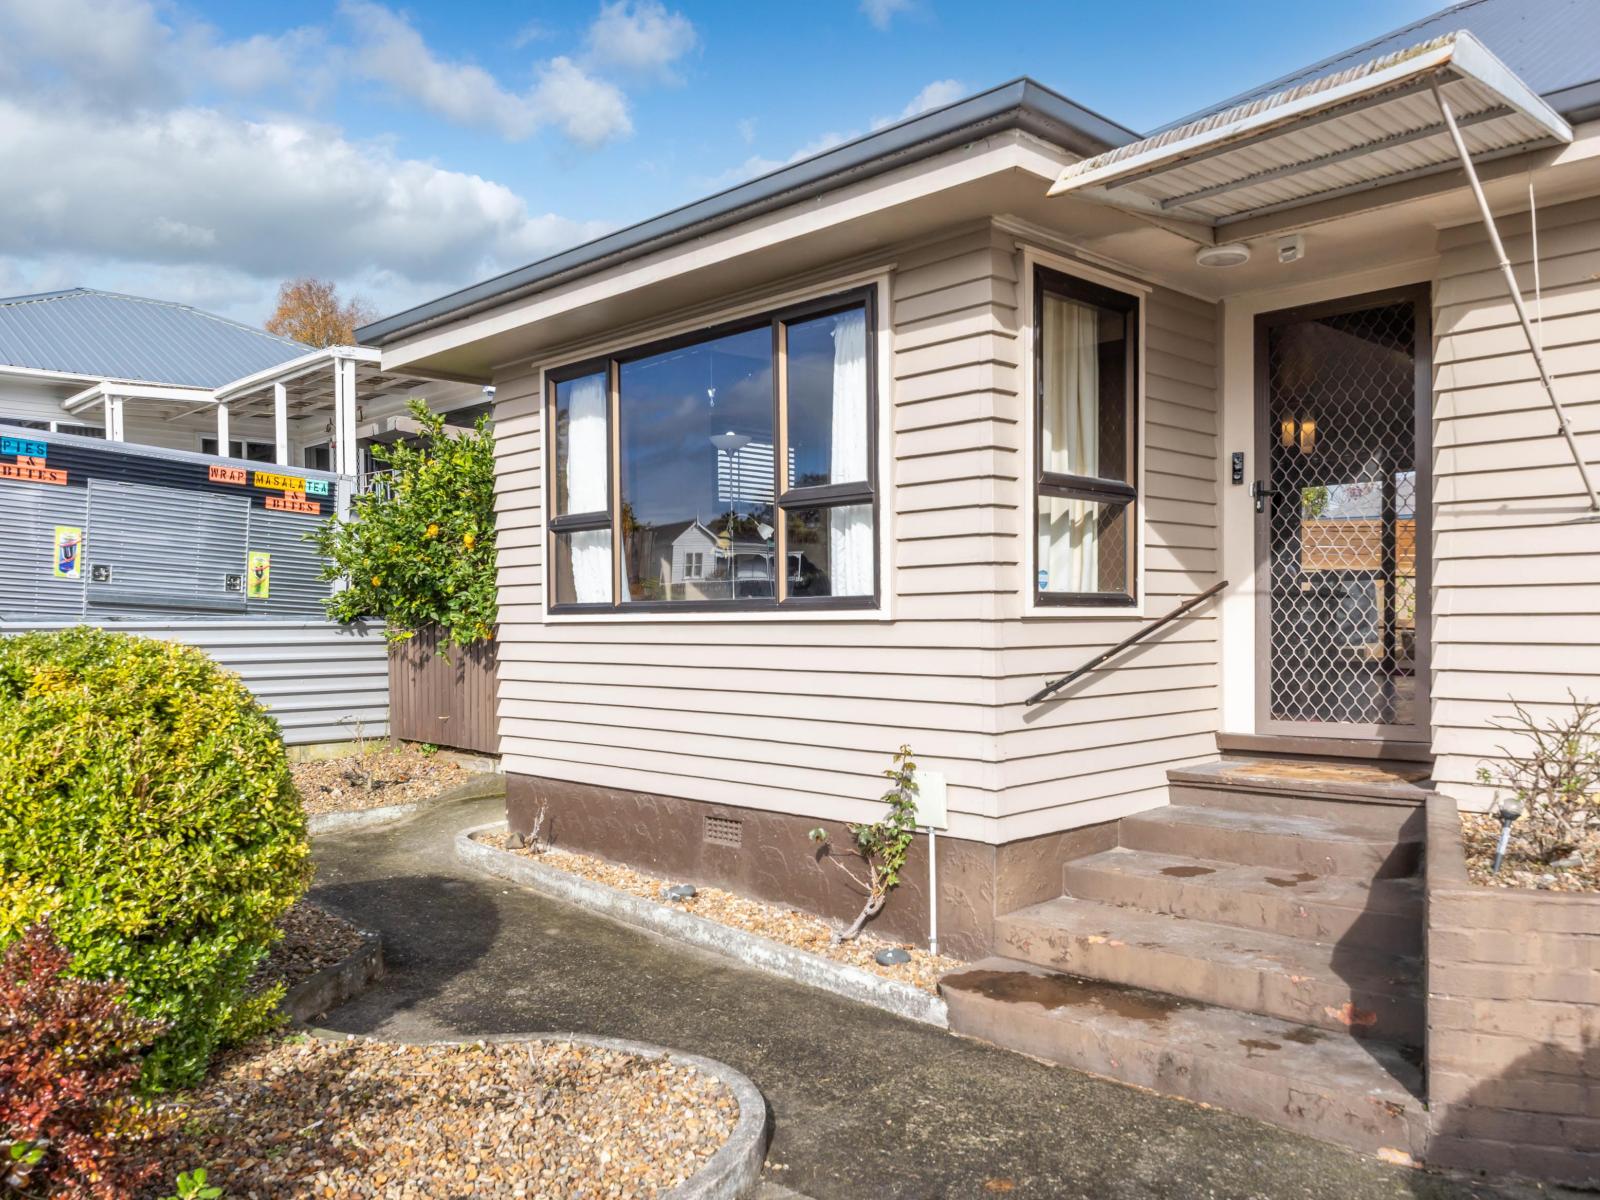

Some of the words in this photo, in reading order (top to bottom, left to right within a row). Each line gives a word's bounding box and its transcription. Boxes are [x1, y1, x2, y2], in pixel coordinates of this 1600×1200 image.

[3, 440, 46, 455] PIES
[2, 466, 57, 481] BITES
[210, 467, 244, 481] WRAP
[256, 474, 304, 490] MASALA
[307, 481, 327, 493] TEA
[272, 499, 313, 512] BITES
